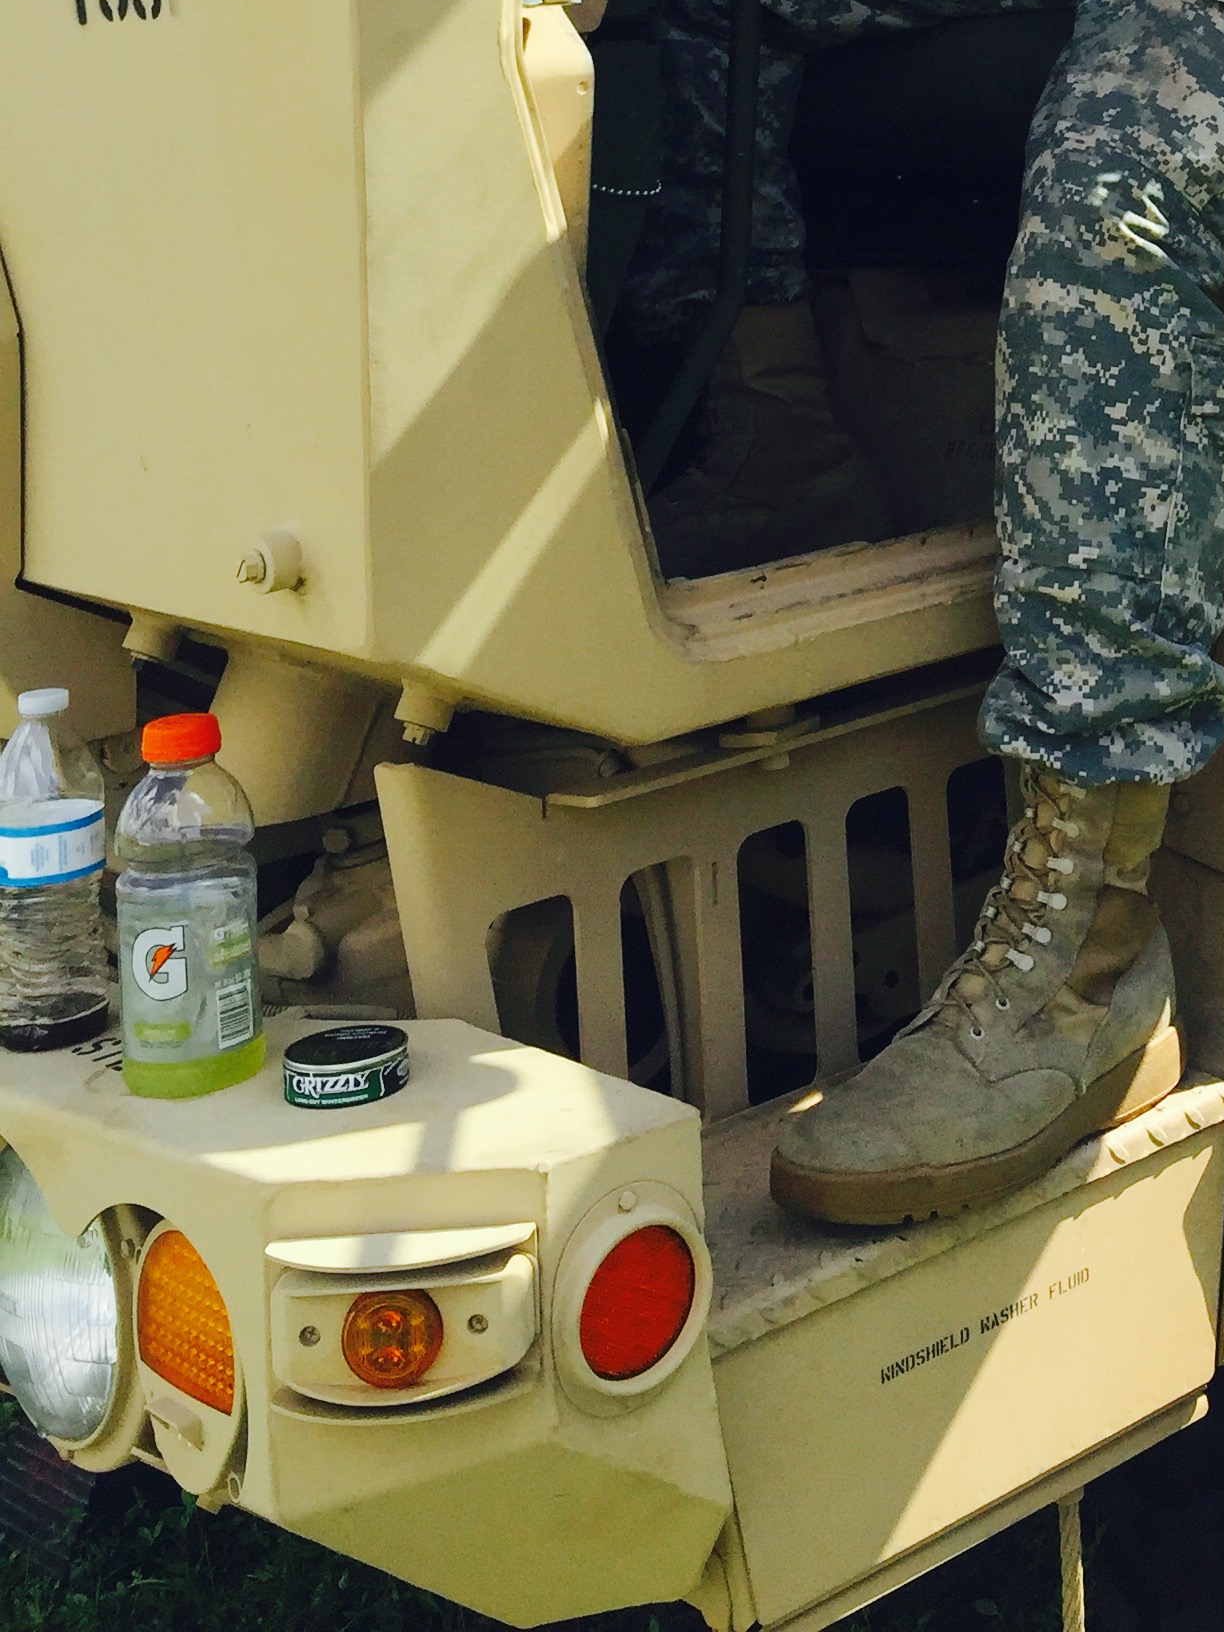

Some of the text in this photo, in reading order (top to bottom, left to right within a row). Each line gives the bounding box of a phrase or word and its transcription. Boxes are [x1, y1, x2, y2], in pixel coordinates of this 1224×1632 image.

[131, 924, 189, 1002] G
[292, 1071, 370, 1099] GRIZZLY
[880, 1267, 1090, 1385] WINDSHIELD WASHER FLUID
